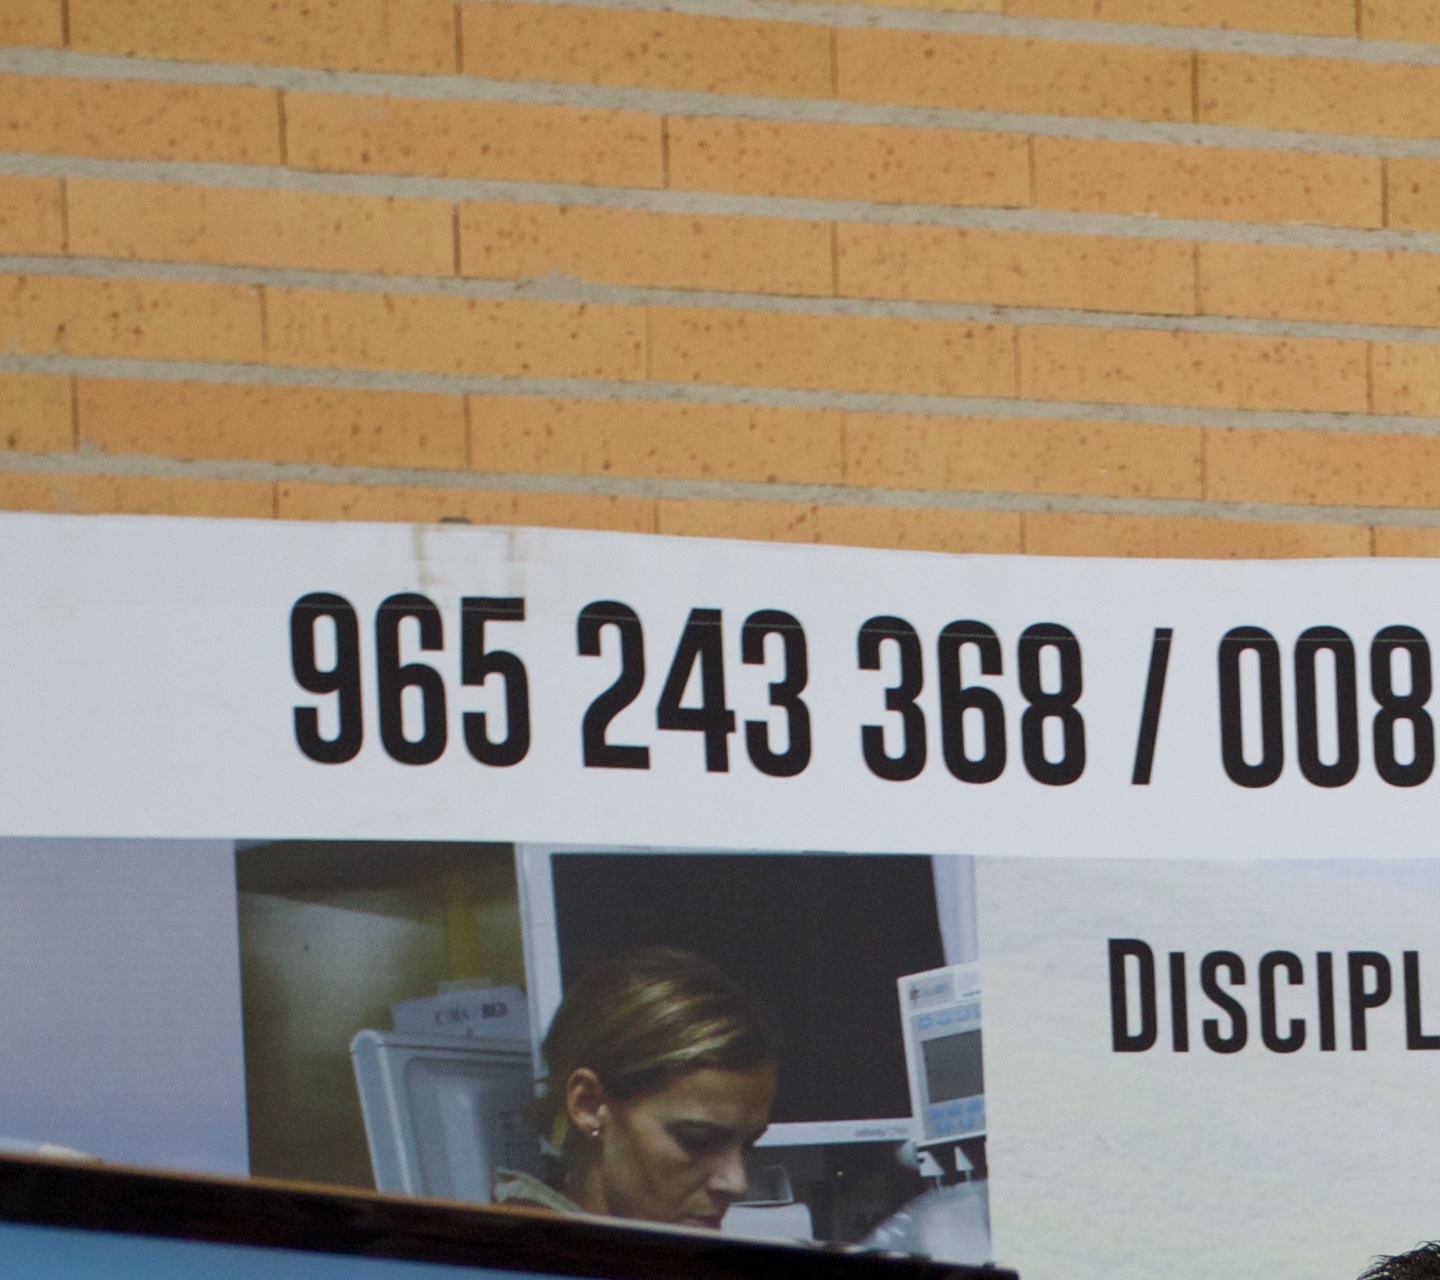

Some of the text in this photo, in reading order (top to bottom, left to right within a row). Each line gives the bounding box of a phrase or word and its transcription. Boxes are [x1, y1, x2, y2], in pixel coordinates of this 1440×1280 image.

[288, 592, 1437, 790] 965 243 368 / 008
